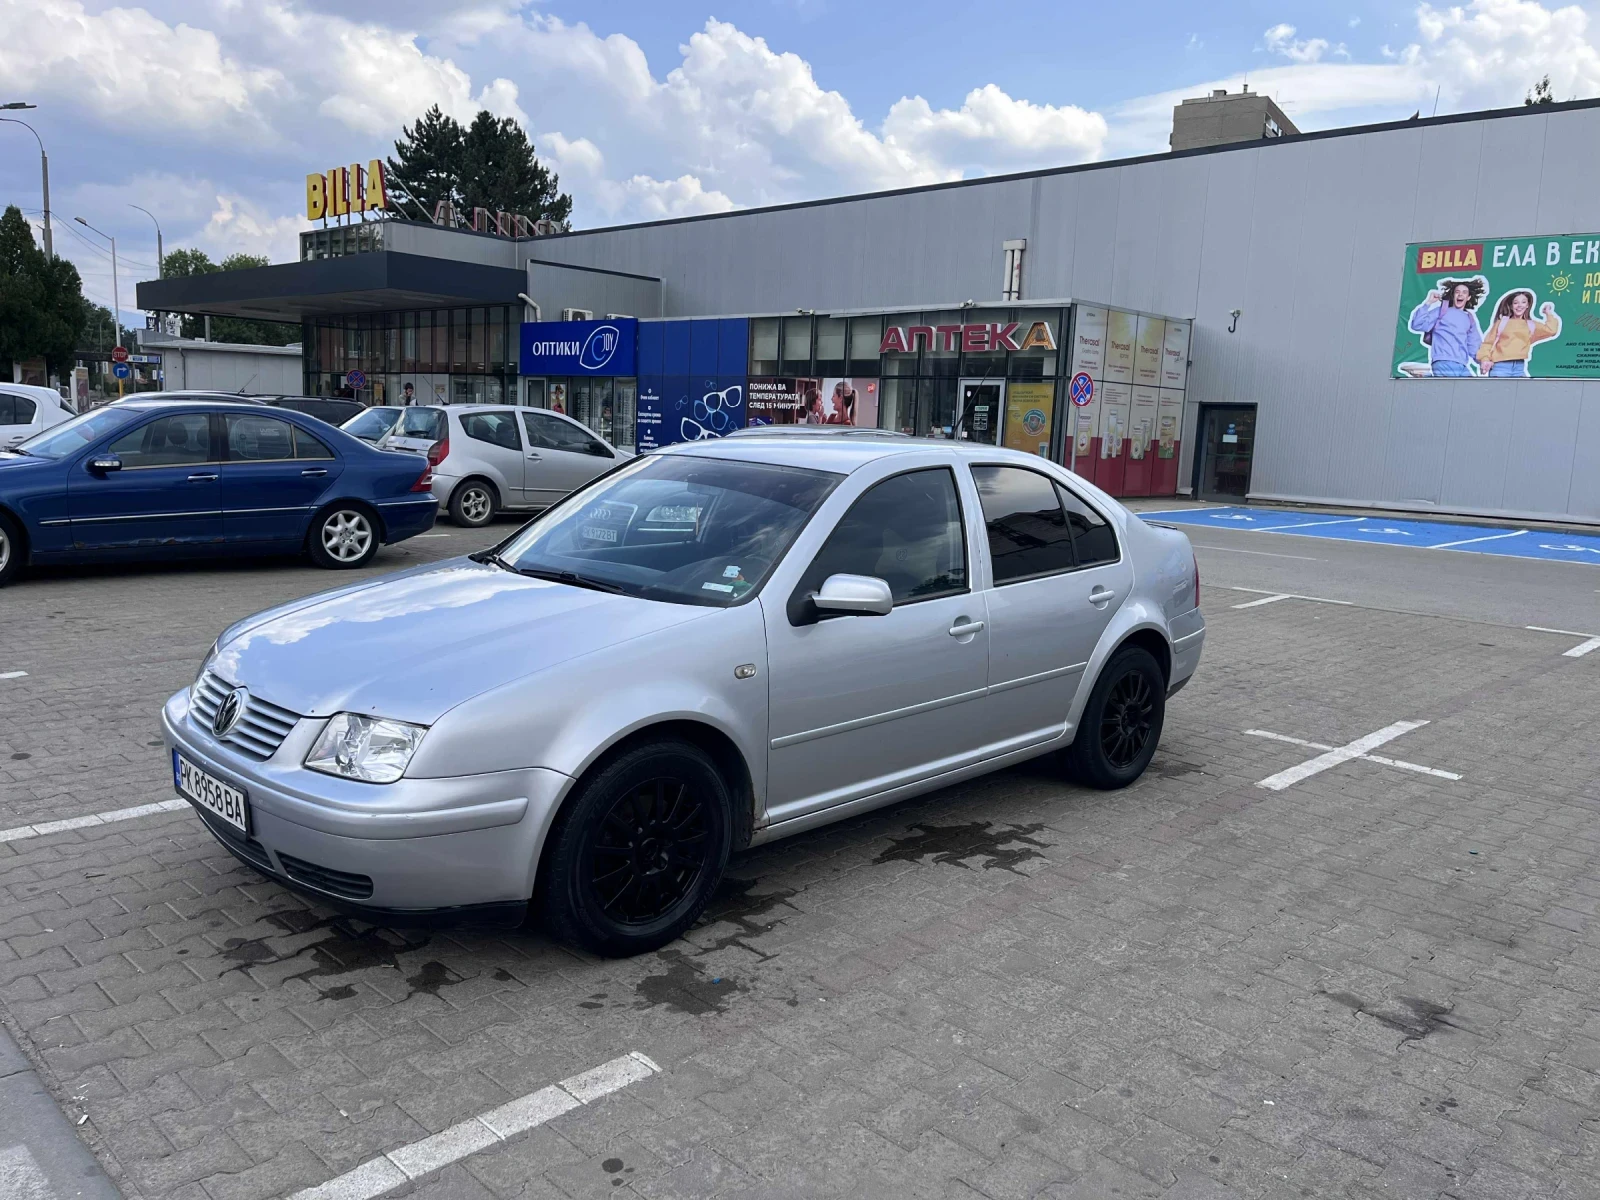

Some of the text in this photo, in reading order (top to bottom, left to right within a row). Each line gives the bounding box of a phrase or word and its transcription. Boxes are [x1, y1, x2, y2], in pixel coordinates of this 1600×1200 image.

[306, 159, 387, 221] BILLA
[1421, 248, 1478, 269] BILLA
[1492, 243, 1536, 268] ЕЛА
[1546, 241, 1561, 266] В
[532, 341, 580, 356] ОПТИКИ
[878, 321, 1057, 353] АПТЕКА
[748, 402, 765, 410] СЛЕД
